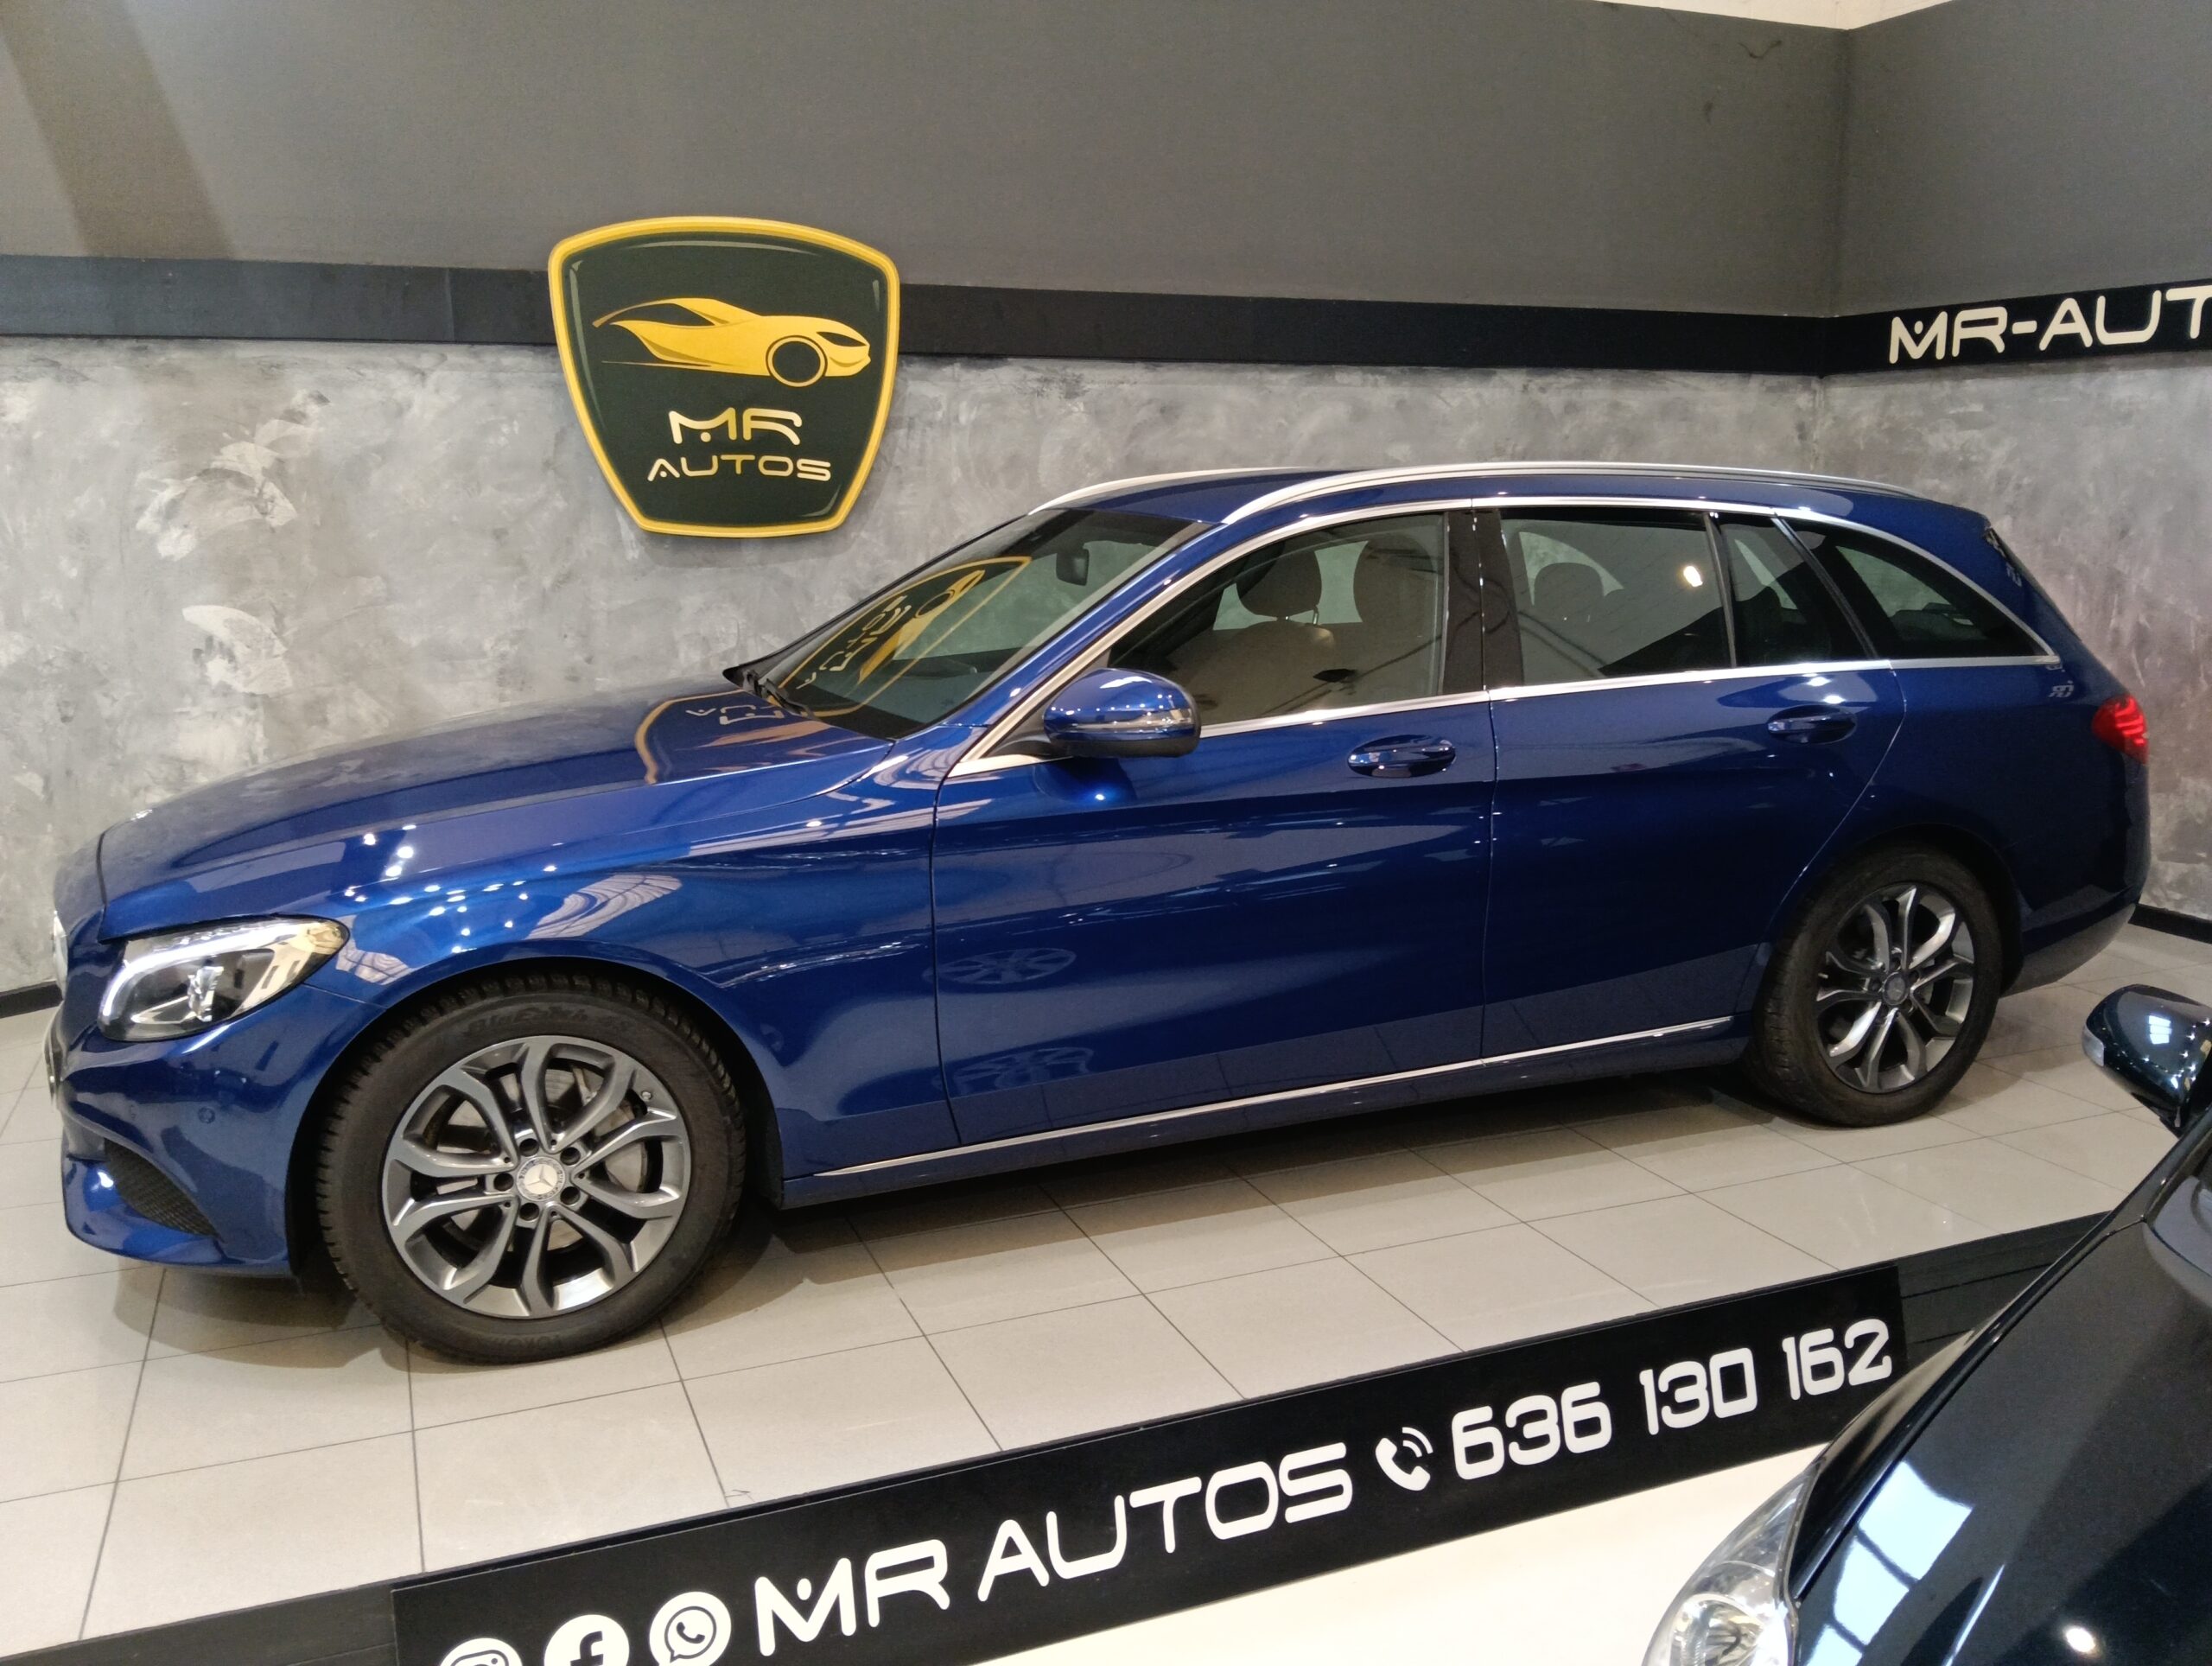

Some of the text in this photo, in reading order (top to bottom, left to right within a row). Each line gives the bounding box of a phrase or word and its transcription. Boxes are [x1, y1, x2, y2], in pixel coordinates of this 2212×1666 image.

[1890, 284, 2212, 364] MR-AUT
[669, 407, 803, 446] MR
[647, 455, 831, 482] AUTOS
[754, 1319, 1892, 1656] MR AUTOS 636 130 162
